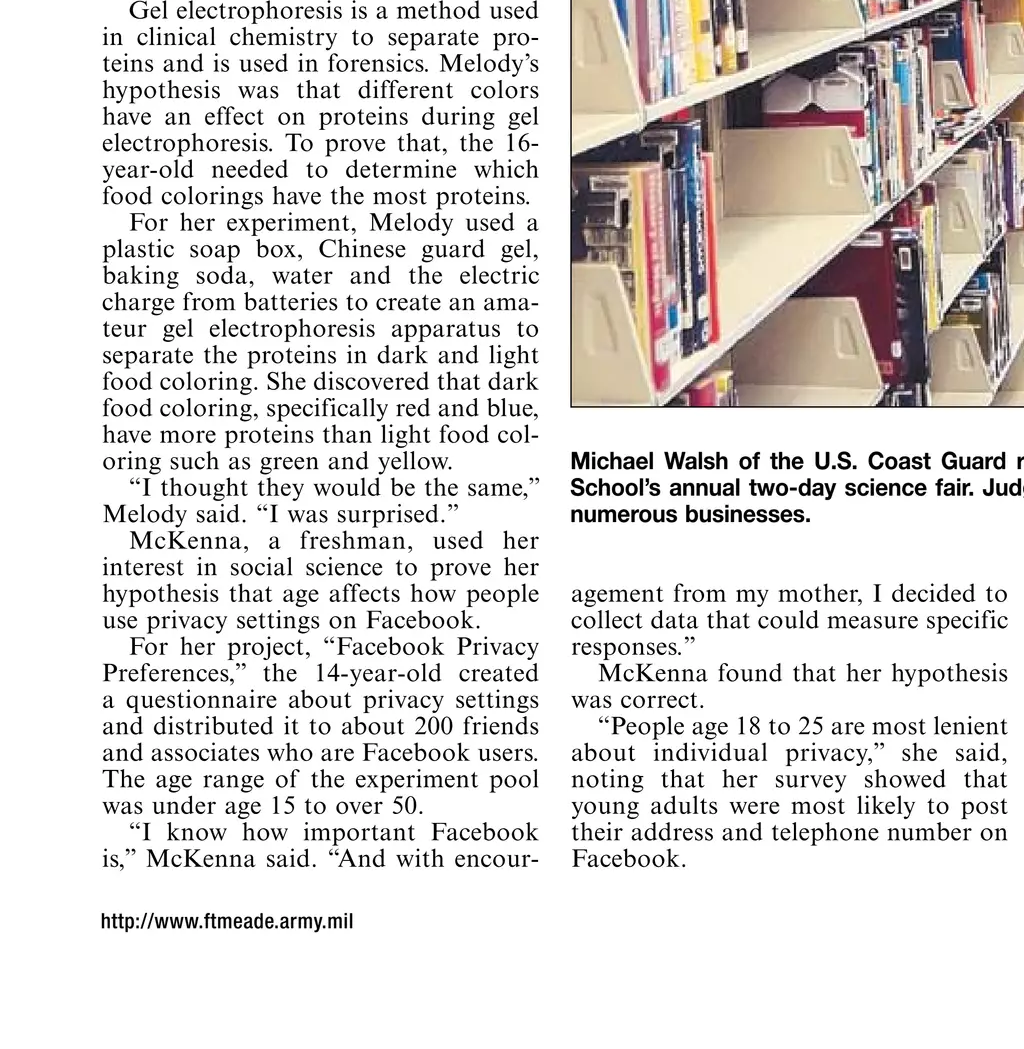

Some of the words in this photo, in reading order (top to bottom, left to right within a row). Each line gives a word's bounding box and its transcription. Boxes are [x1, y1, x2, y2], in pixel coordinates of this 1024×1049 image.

[572, 452, 653, 470] Michael
[664, 452, 728, 470] Walsh
[739, 452, 760, 470] of
[770, 452, 804, 470] the
[815, 451, 857, 470] U.S.
[868, 451, 931, 470] Coast
[942, 451, 1005, 470] Guard
[571, 478, 660, 496] School’s
[670, 478, 740, 496] annual
[749, 478, 836, 500] two-day
[845, 478, 927, 496] science
[935, 478, 973, 496] fair.
[571, 509, 677, 523] numerous
[686, 505, 810, 523] businesses.
[572, 586, 663, 607] agement
[674, 583, 726, 602] from
[736, 589, 769, 607] my
[779, 583, 862, 606] mother,
[873, 584, 881, 602] I
[892, 583, 975, 602] decided
[986, 586, 1007, 602] to
[130, 637, 168, 655] For
[180, 636, 215, 655] her
[228, 636, 310, 660] project,
[324, 636, 444, 655] “Facebook
[457, 636, 539, 660] Privacy
[599, 663, 708, 682] McKenna
[719, 663, 782, 682] found
[793, 663, 836, 682] that
[846, 663, 881, 682] her
[892, 663, 1007, 687] hypothesis
[103, 848, 136, 871] is,”
[147, 849, 255, 867] McKenna
[267, 848, 316, 867] said.
[329, 849, 385, 867] “And
[396, 848, 444, 867] with
[455, 854, 538, 867] encour-
[572, 848, 685, 867] Facebook.
[102, 913, 353, 933] http://www.ftmeade.army.mil
